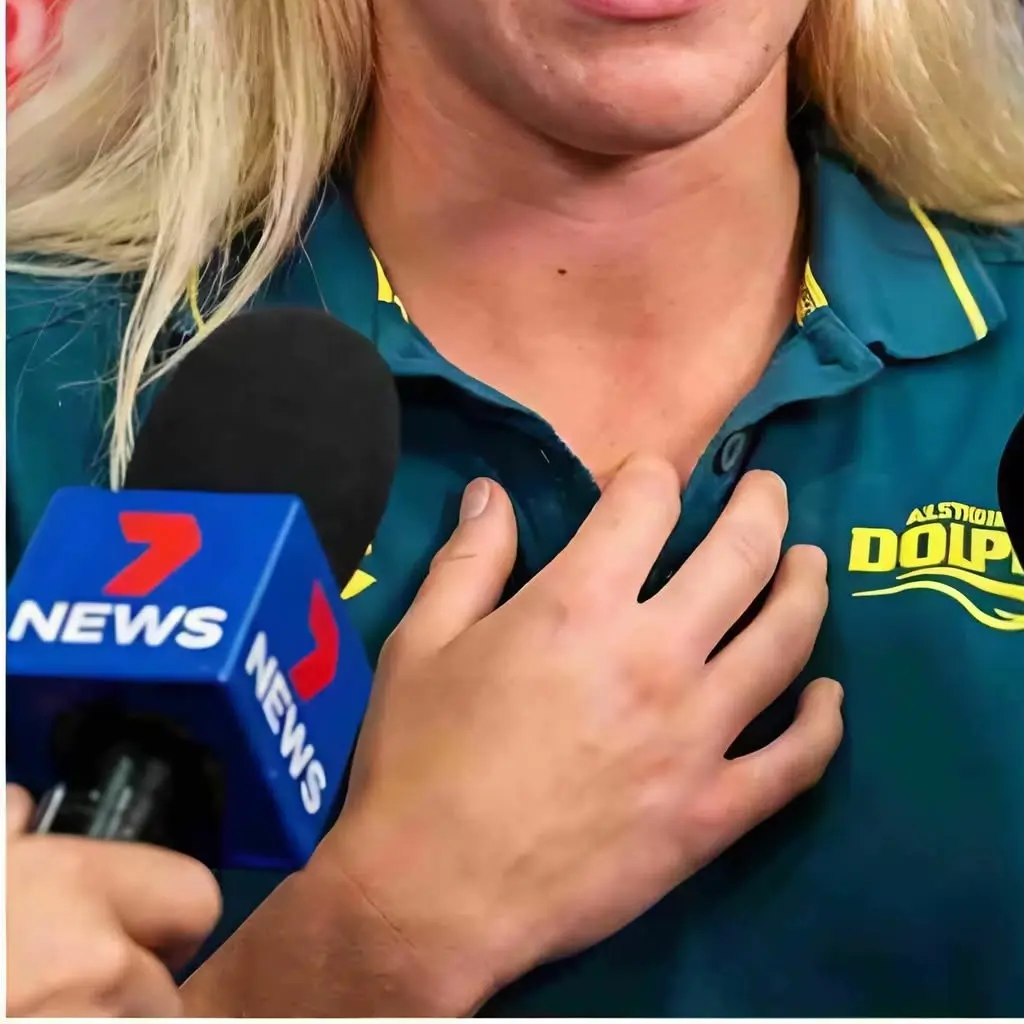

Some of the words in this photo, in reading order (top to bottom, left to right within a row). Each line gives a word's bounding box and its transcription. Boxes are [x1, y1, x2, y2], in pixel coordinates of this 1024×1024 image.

[103, 511, 202, 597] 7
[7, 600, 228, 650] NEWS
[245, 631, 327, 815] NEWS
